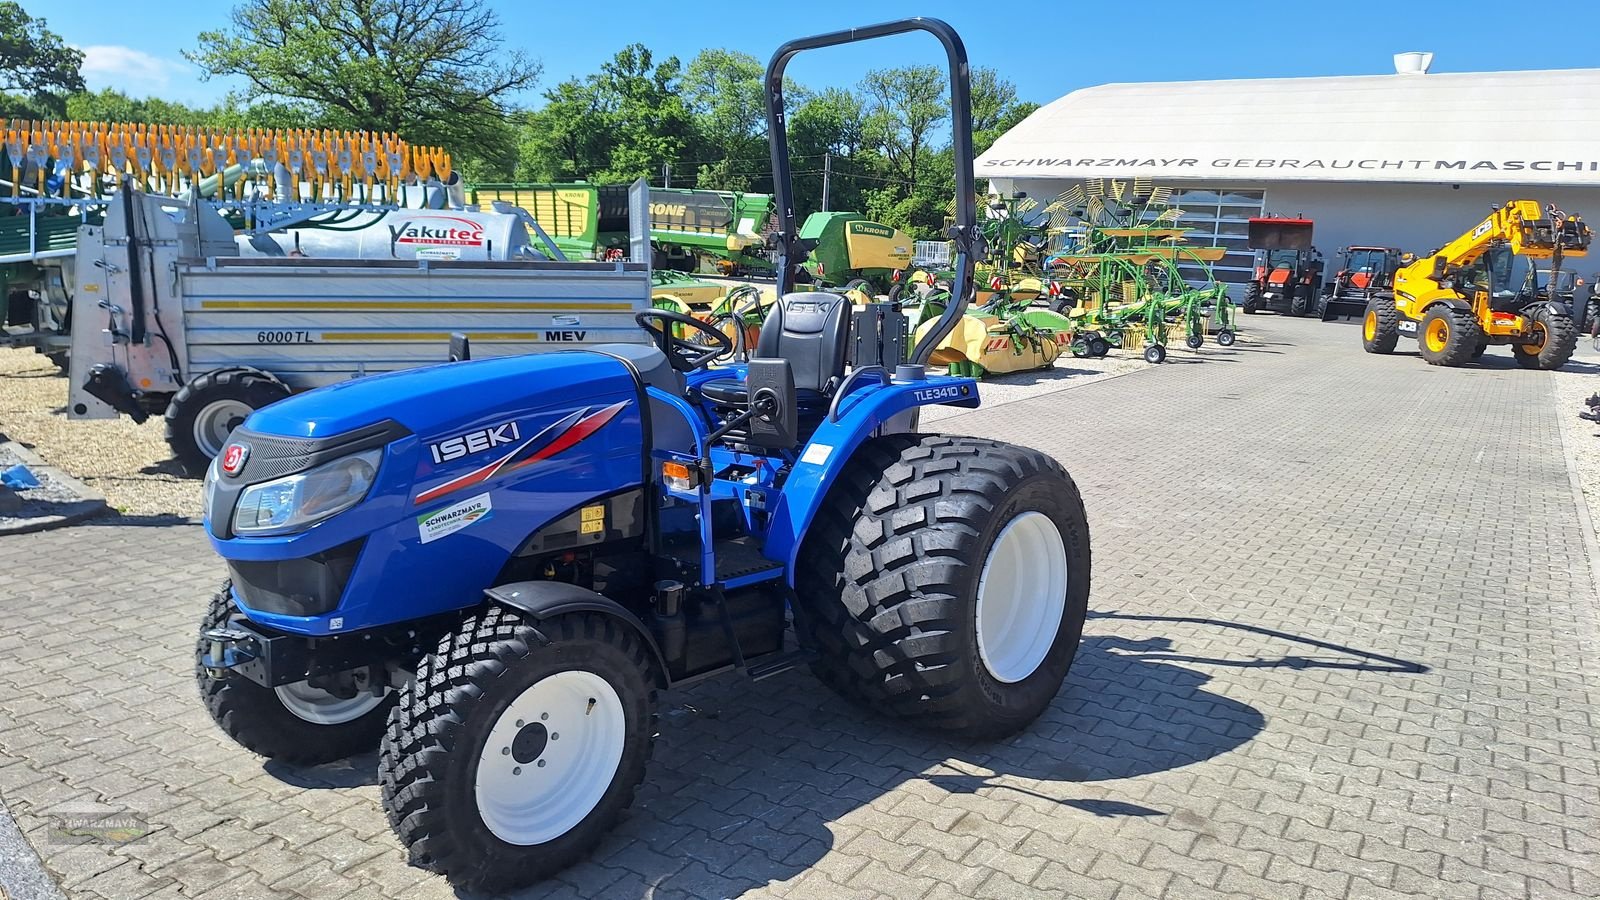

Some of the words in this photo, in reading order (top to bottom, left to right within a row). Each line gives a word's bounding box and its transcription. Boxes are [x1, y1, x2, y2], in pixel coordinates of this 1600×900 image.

[983, 158, 1198, 168] SCHWARZMAYR
[649, 203, 686, 217] RONE
[864, 227, 889, 236] KRONE
[1472, 219, 1493, 241] JCB
[388, 222, 483, 259] Yakutec
[1399, 321, 1417, 331] JCB
[545, 331, 586, 341] MEV
[913, 386, 958, 402] TLE3410
[430, 421, 520, 464] ISEKI
[425, 502, 482, 527] SCHWARZMAYR
